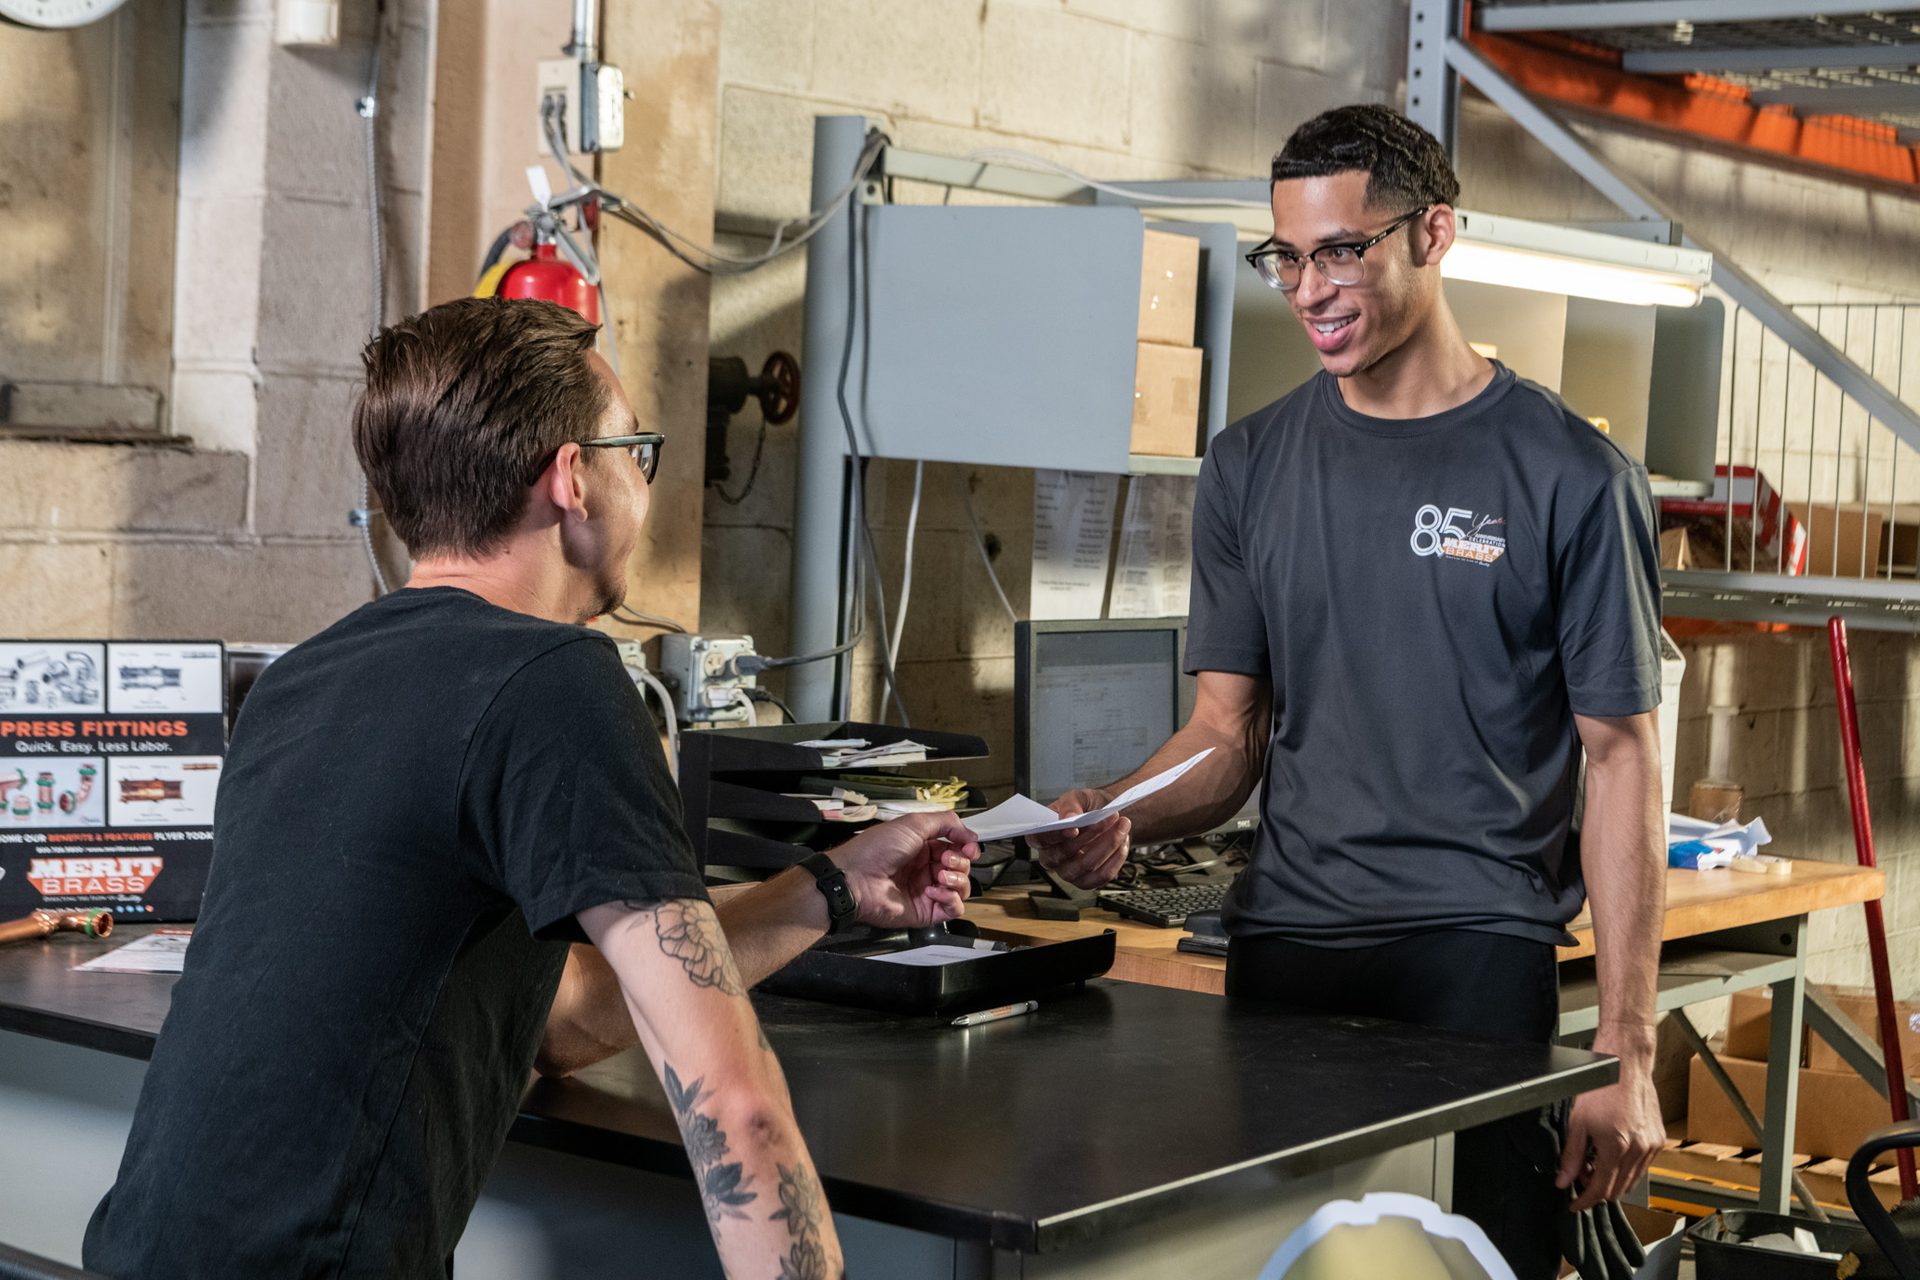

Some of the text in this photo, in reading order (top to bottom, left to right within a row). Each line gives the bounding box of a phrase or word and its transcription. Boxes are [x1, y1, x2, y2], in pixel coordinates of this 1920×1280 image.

[1410, 504, 1473, 559] 85
[1443, 537, 1504, 556] MERIT
[1446, 547, 1495, 563] BRASS
[0, 720, 188, 737] PRESS FITTINGS
[15, 740, 173, 754] Quick. Easy. Less Labor.
[153, 831, 185, 840] FLYER
[185, 830, 214, 840] TODA
[31, 858, 162, 878] MERIT
[42, 877, 145, 894] BRASS
